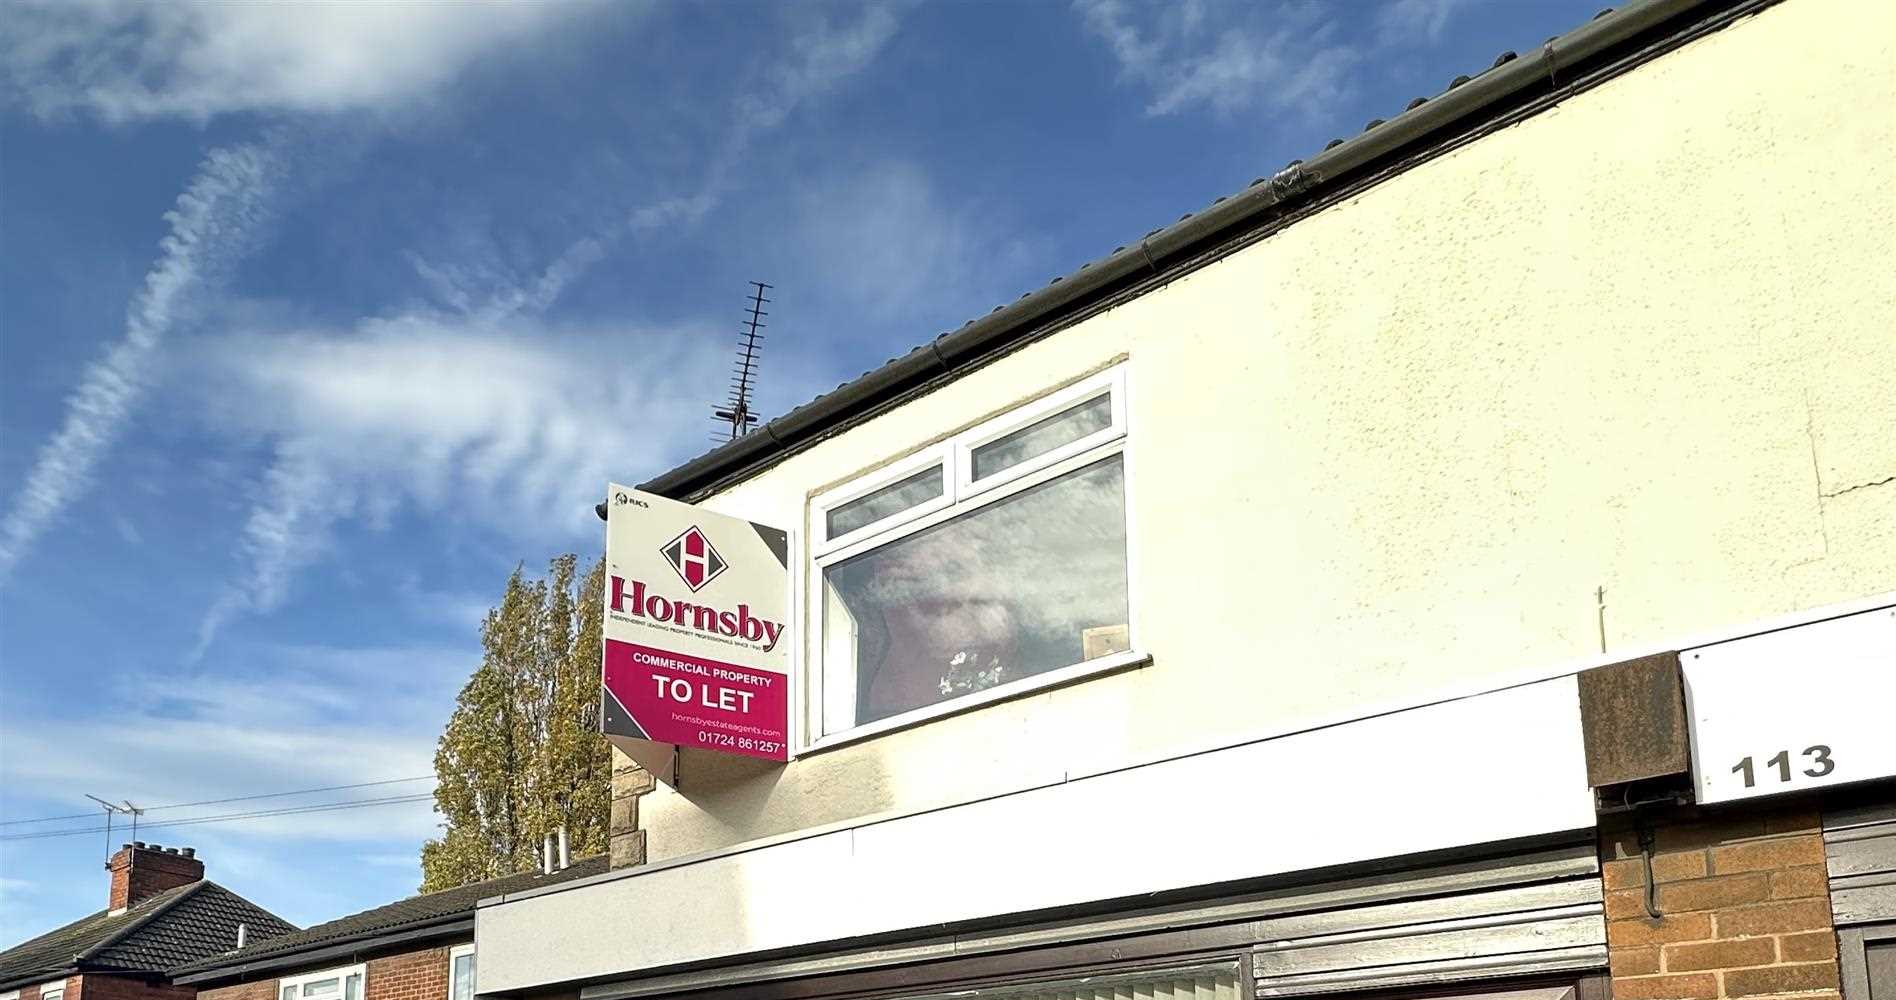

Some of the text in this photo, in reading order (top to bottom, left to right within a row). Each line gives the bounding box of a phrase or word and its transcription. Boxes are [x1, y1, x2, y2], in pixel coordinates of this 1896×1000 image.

[610, 575, 785, 652] Hornsby
[633, 652, 772, 688] COMMERCIAL PROPERTY
[652, 674, 754, 713] TO LET
[671, 712, 781, 737] hornsbyestateagents.com
[698, 730, 780, 753] 01724 861257
[1731, 744, 1835, 788] 113
